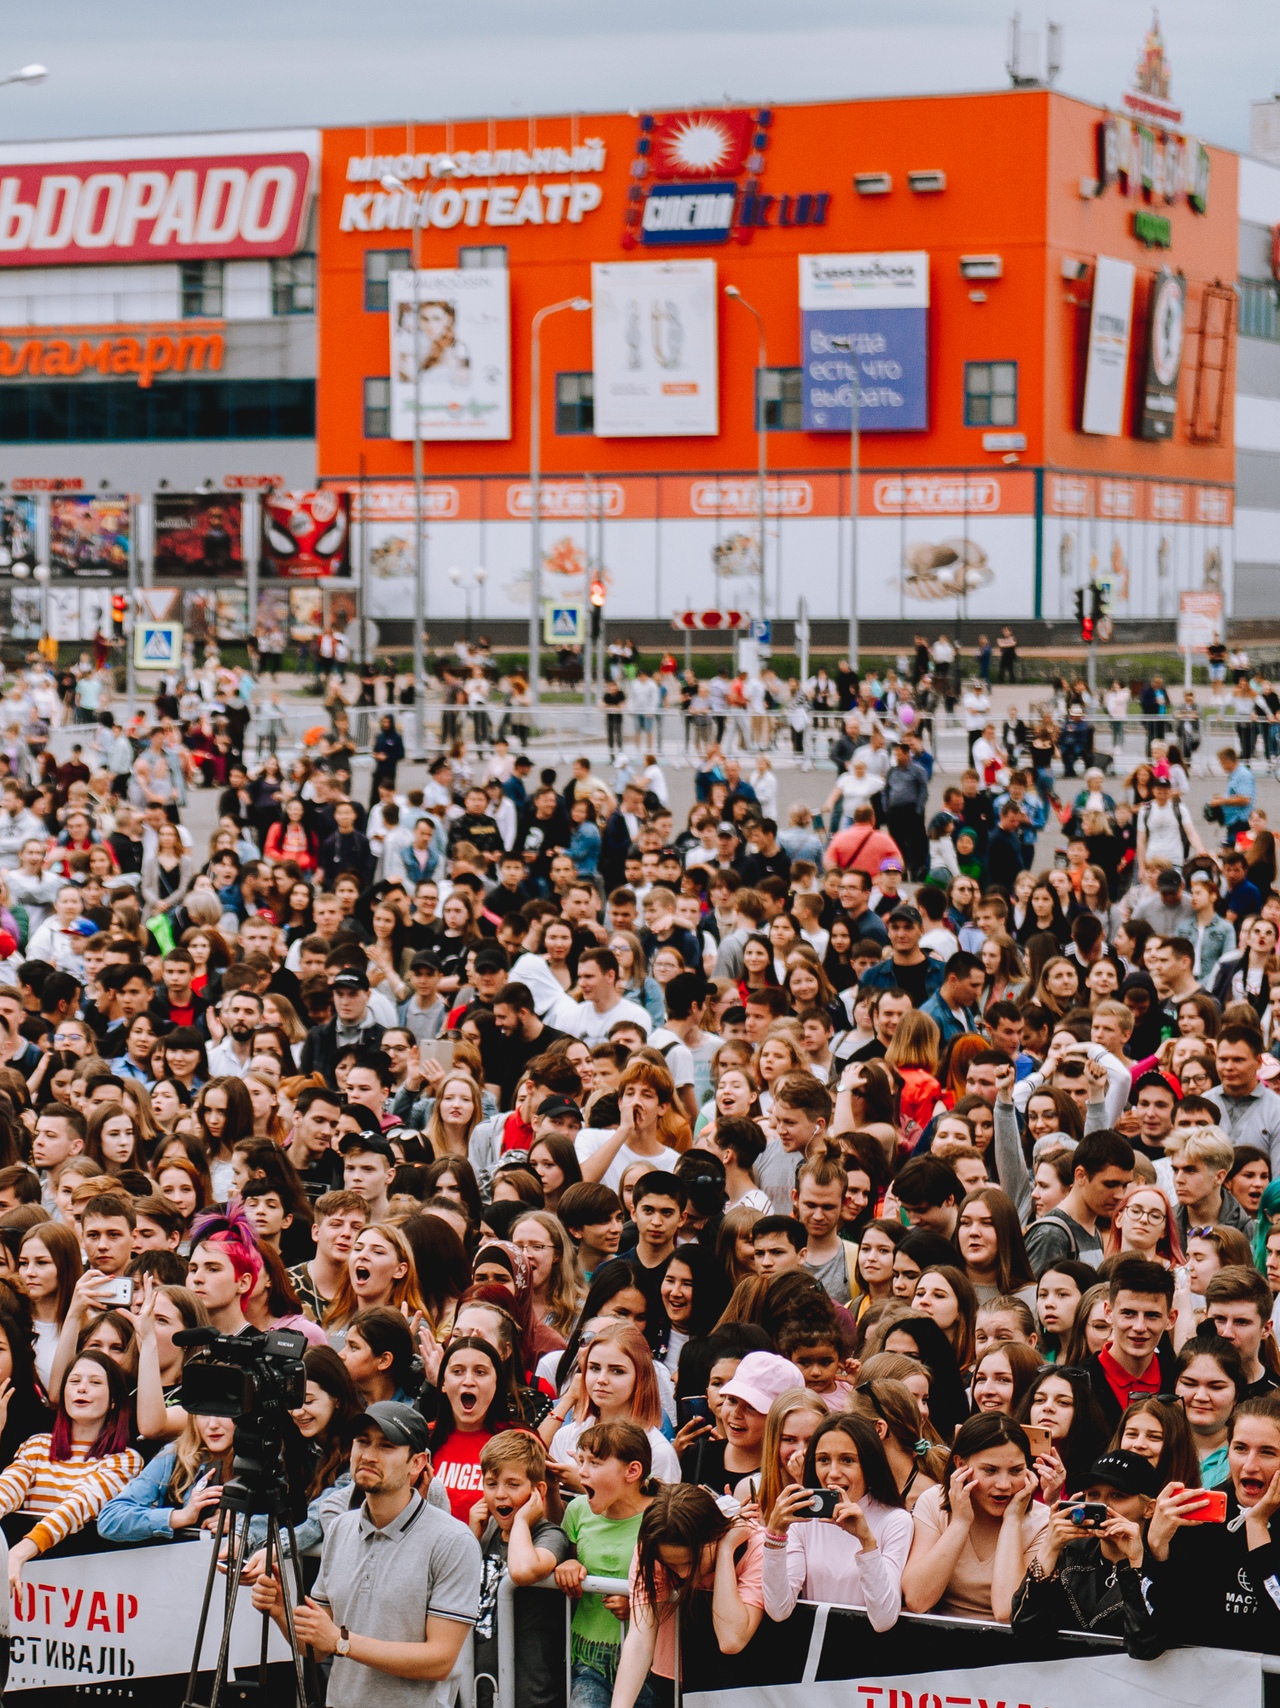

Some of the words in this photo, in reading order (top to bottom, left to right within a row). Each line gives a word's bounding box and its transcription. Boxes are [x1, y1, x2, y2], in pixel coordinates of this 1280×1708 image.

[345, 137, 606, 182] МНОГОЗАЛЬНЫЙ
[339, 181, 603, 232] КИНОТЕАТР
[810, 329, 887, 356] Всегда
[810, 360, 858, 381] есть
[862, 359, 903, 381] что
[810, 384, 904, 408] выбрать
[223, 473, 284, 489] СКОРО
[14, 1582, 139, 1634] ОТУАР
[10, 1635, 135, 1677] СТИВАЛЬ
[11, 1676, 47, 1686] НОГО
[75, 1685, 134, 1698] СПОРТА
